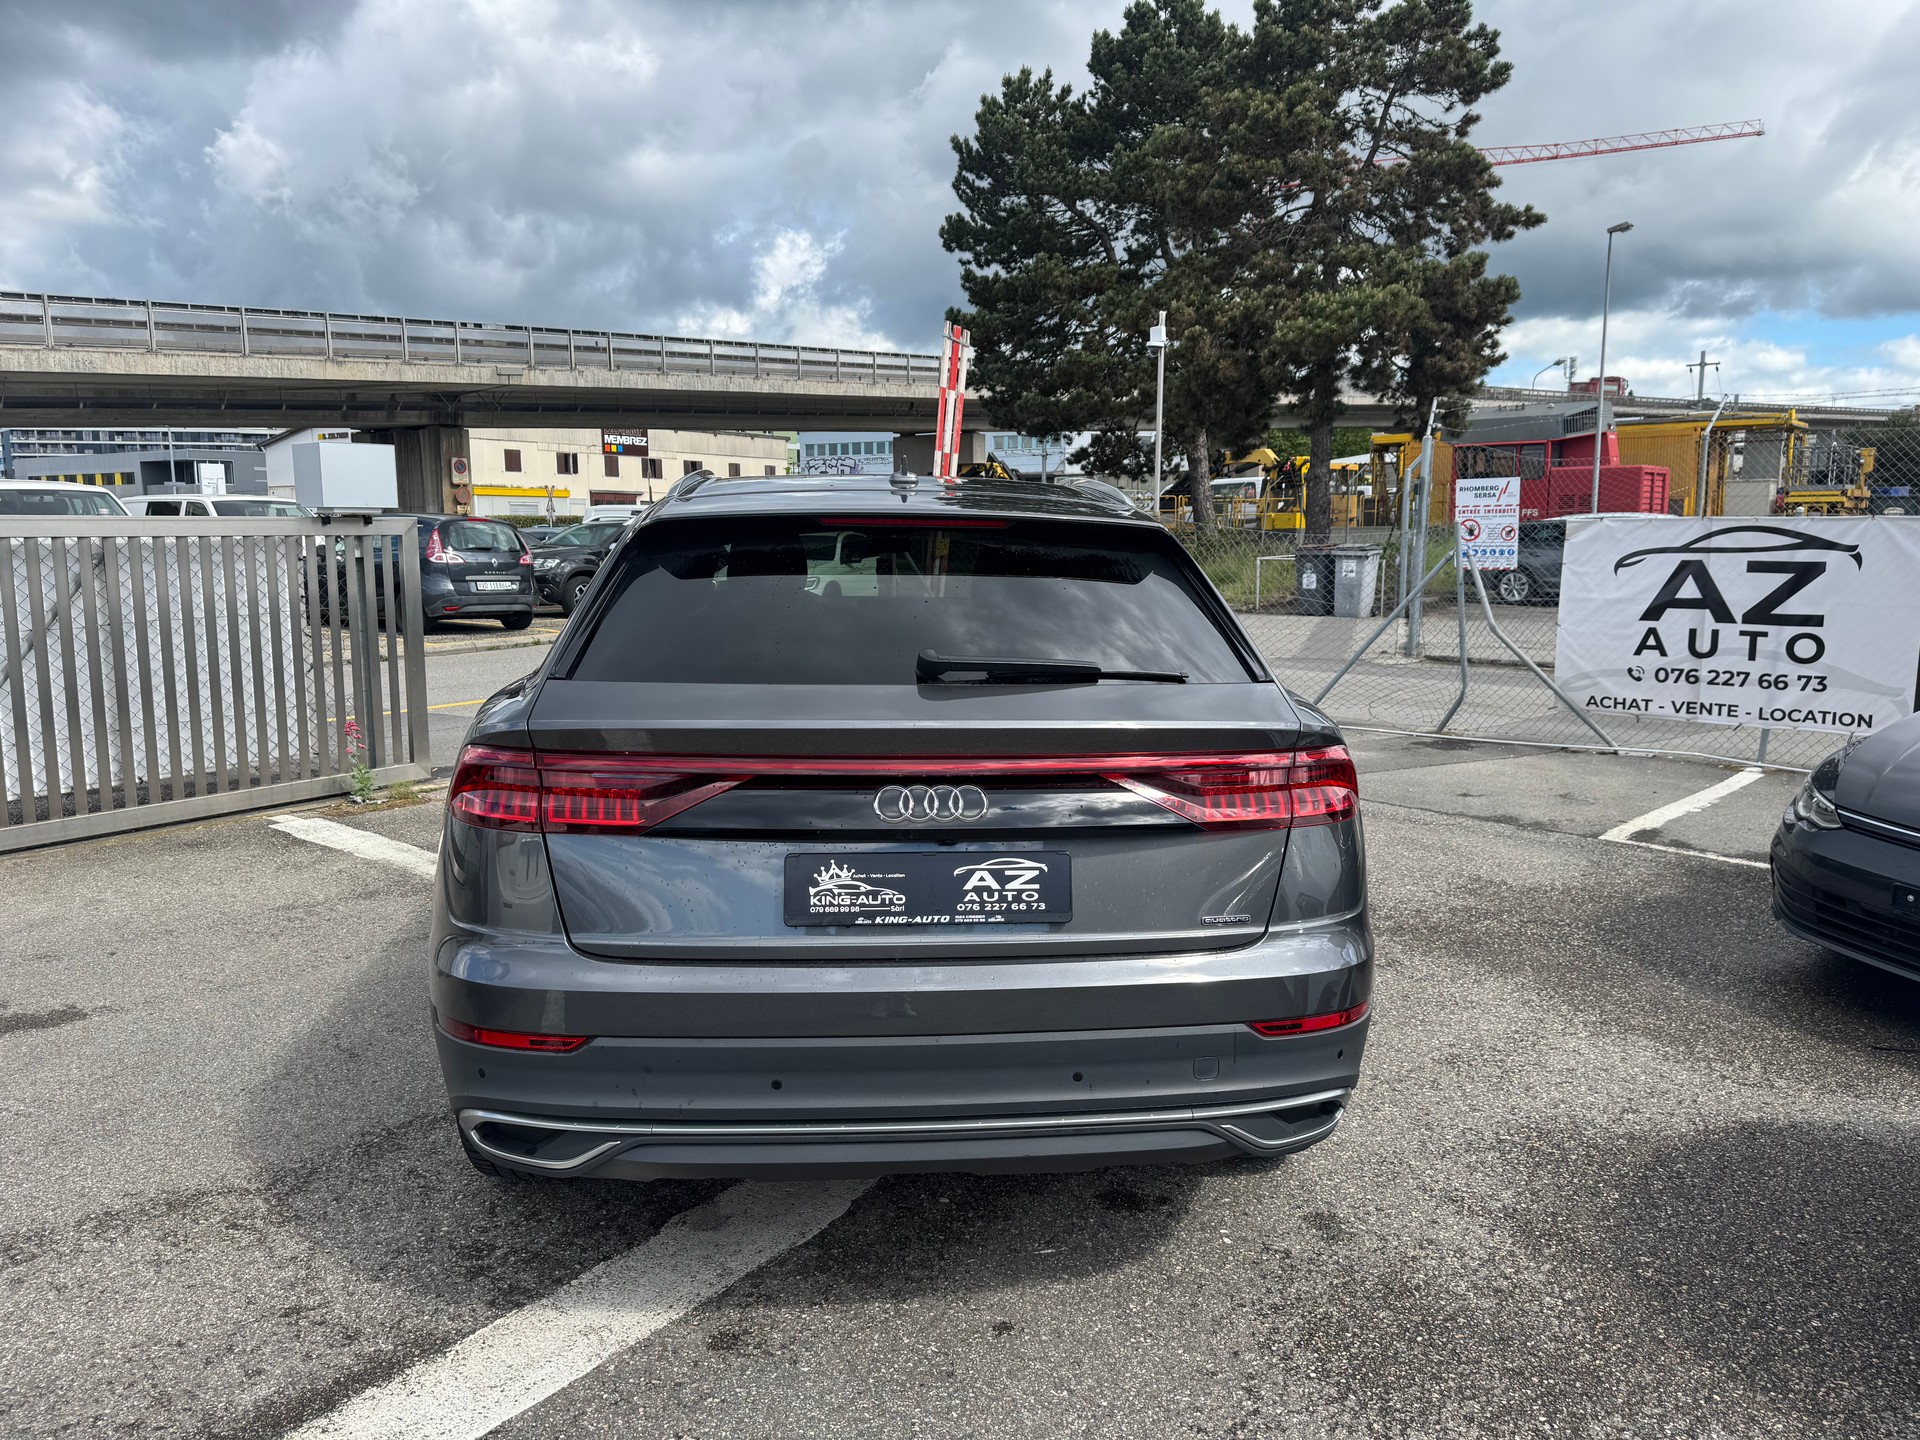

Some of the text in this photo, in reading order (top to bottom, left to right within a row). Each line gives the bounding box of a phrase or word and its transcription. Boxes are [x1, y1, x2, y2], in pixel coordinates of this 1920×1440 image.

[604, 434, 647, 445] MEMBREZ
[1459, 485, 1499, 493] RHOMBERG
[1521, 508, 1539, 518] FFS
[1638, 559, 1827, 628] AZ
[1632, 626, 1826, 665] AUTO
[1655, 667, 1828, 693] 076 227 66 73
[1585, 695, 1654, 712] ACHAT
[1671, 700, 1739, 718] VENTE
[1758, 707, 1873, 729] LOCATION
[963, 870, 1041, 890] AZ
[963, 891, 1039, 902] AUTO
[956, 902, 1046, 911] 076 227 66 73
[875, 915, 951, 924] KING-AUTO
